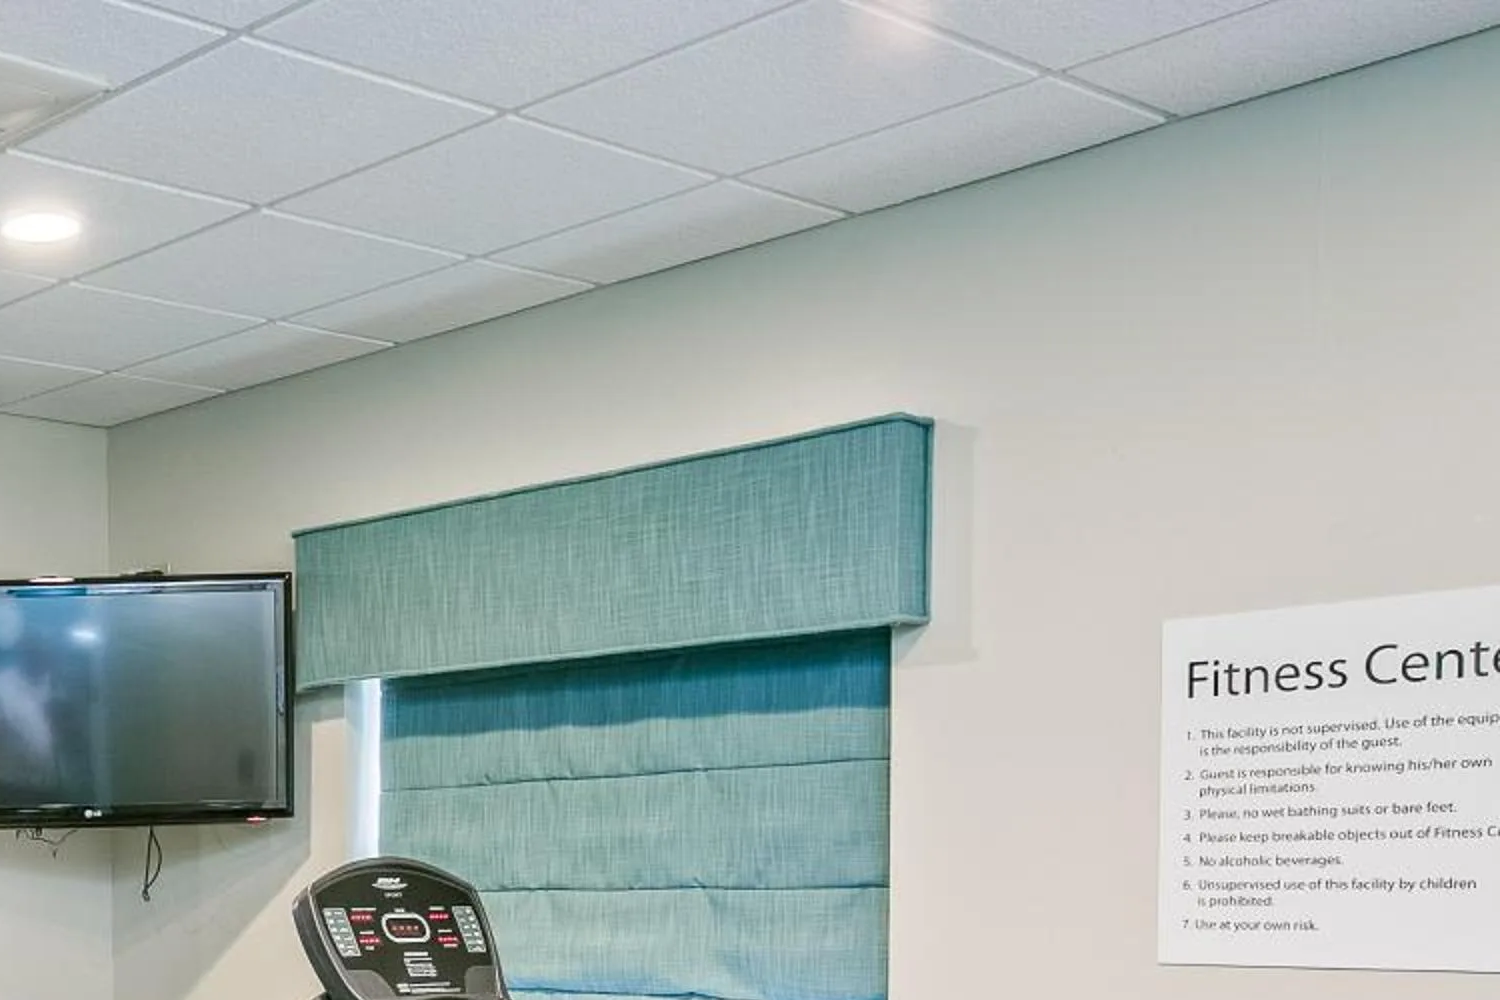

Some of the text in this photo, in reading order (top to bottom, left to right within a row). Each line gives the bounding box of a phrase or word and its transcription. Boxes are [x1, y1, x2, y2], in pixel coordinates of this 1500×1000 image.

[1187, 641, 1500, 699] Fitness Cent
[1200, 728, 1224, 740] This
[1227, 726, 1267, 740] facility
[1269, 726, 1279, 737] is
[1281, 724, 1303, 736] not
[1306, 718, 1381, 736] supervised.
[1385, 716, 1410, 729] Use
[1413, 715, 1428, 728] of
[1431, 715, 1455, 727] the
[1200, 736, 1402, 757] is the responsibility of the guest.
[1200, 768, 1235, 781] Guest
[1237, 768, 1247, 779] is
[1250, 763, 1322, 779] responsible
[1324, 762, 1342, 775] for
[1345, 761, 1405, 775] knowing
[1408, 757, 1457, 771] his/her
[1460, 758, 1493, 770] own
[1199, 783, 1247, 798] physical
[1243, 808, 1259, 819] no
[1261, 807, 1286, 818] wet
[1287, 805, 1338, 819] bathing
[1342, 804, 1371, 815] suits
[1374, 805, 1389, 815] or
[1392, 803, 1423, 814] bare
[1426, 801, 1458, 813] feet.
[1199, 831, 1237, 843] Please
[1239, 831, 1269, 844] keep
[1271, 829, 1335, 842] breakable
[1337, 828, 1386, 843] objects
[1389, 828, 1413, 839] out
[1416, 826, 1431, 839] of
[1434, 826, 1483, 839] Fitness
[1199, 855, 1216, 867] No
[1218, 855, 1273, 867] alcoholic
[1275, 855, 1344, 868] beverages.
[1198, 879, 1281, 892] Unsupervised
[1283, 881, 1306, 891] use
[1308, 878, 1322, 890] of
[1325, 878, 1349, 890] this
[1351, 877, 1395, 892] facility
[1399, 877, 1415, 892] by
[1419, 877, 1477, 891] children
[1197, 895, 1207, 906] is
[1195, 919, 1217, 930] Use
[1219, 920, 1231, 930] at
[1233, 920, 1261, 933] your
[1263, 921, 1291, 931] own
[1293, 919, 1319, 931] risk.
